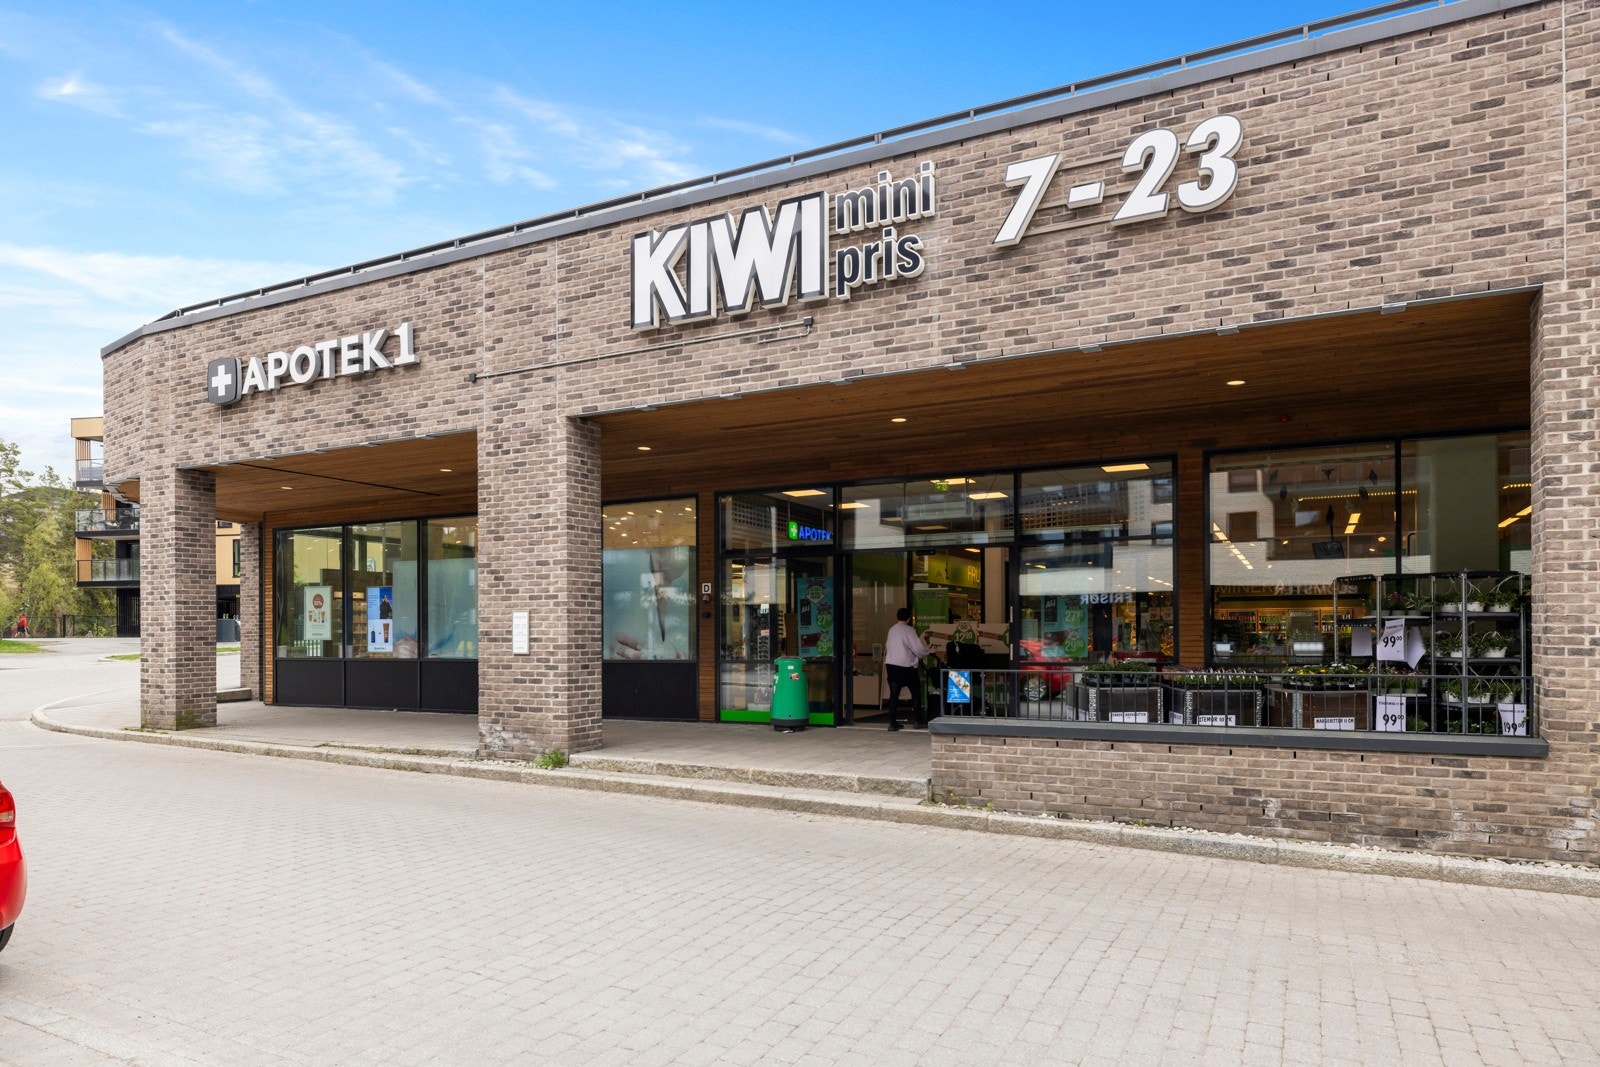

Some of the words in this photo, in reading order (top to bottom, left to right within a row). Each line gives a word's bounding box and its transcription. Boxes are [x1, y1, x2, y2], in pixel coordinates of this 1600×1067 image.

[835, 160, 935, 235] mini
[992, 153, 1063, 248] 7
[1110, 113, 1243, 227] 23
[631, 191, 829, 332] KIWI
[836, 226, 925, 300] pris
[798, 525, 833, 541] APOTEK
[703, 584, 711, 592] D
